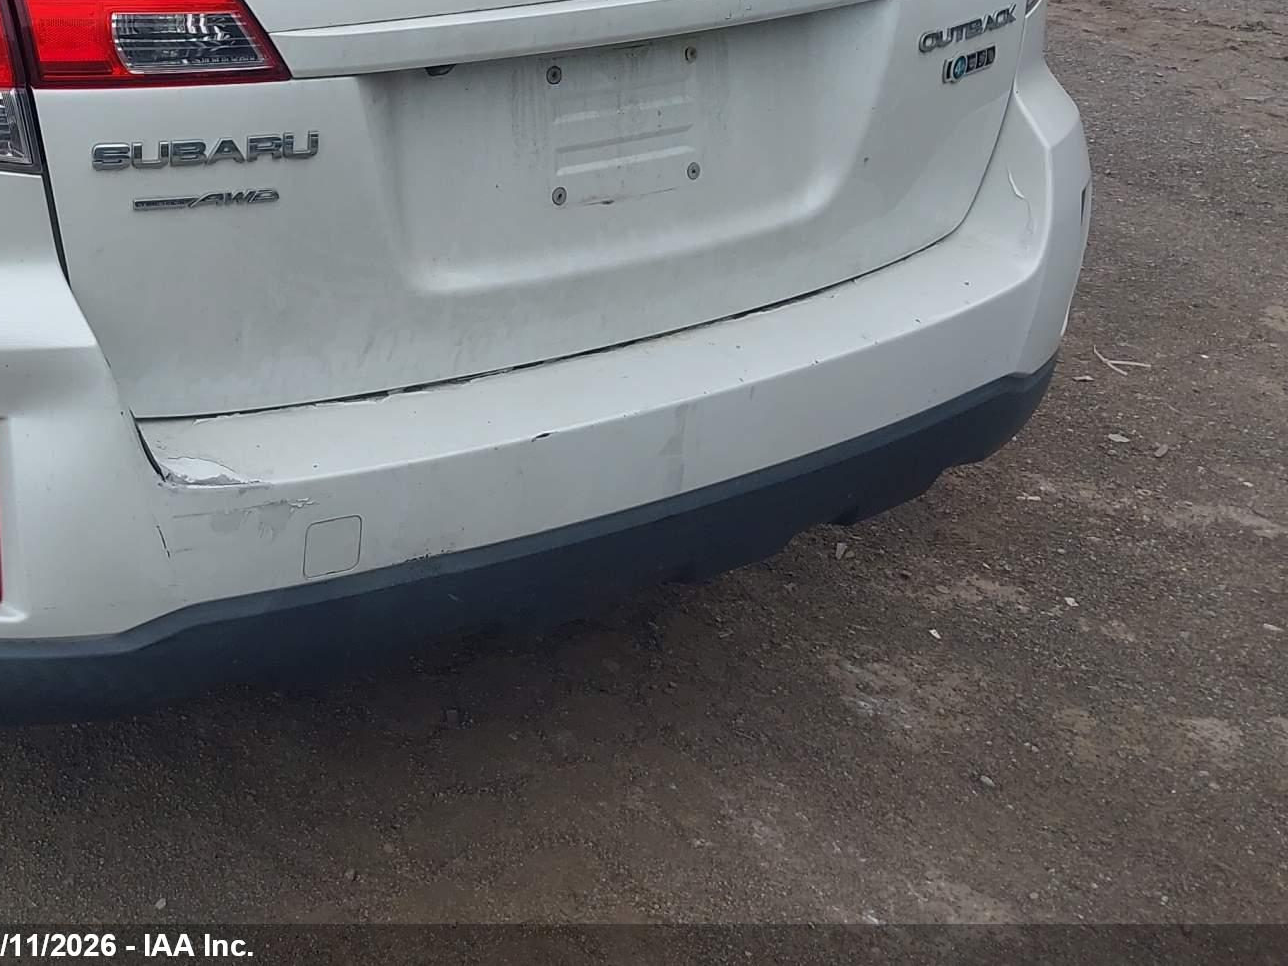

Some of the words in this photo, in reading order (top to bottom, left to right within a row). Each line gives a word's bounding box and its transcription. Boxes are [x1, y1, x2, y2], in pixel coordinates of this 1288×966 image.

[918, 3, 1017, 54] OUTBACK
[91, 130, 320, 171] SUBARU
[188, 189, 280, 209] AWD
